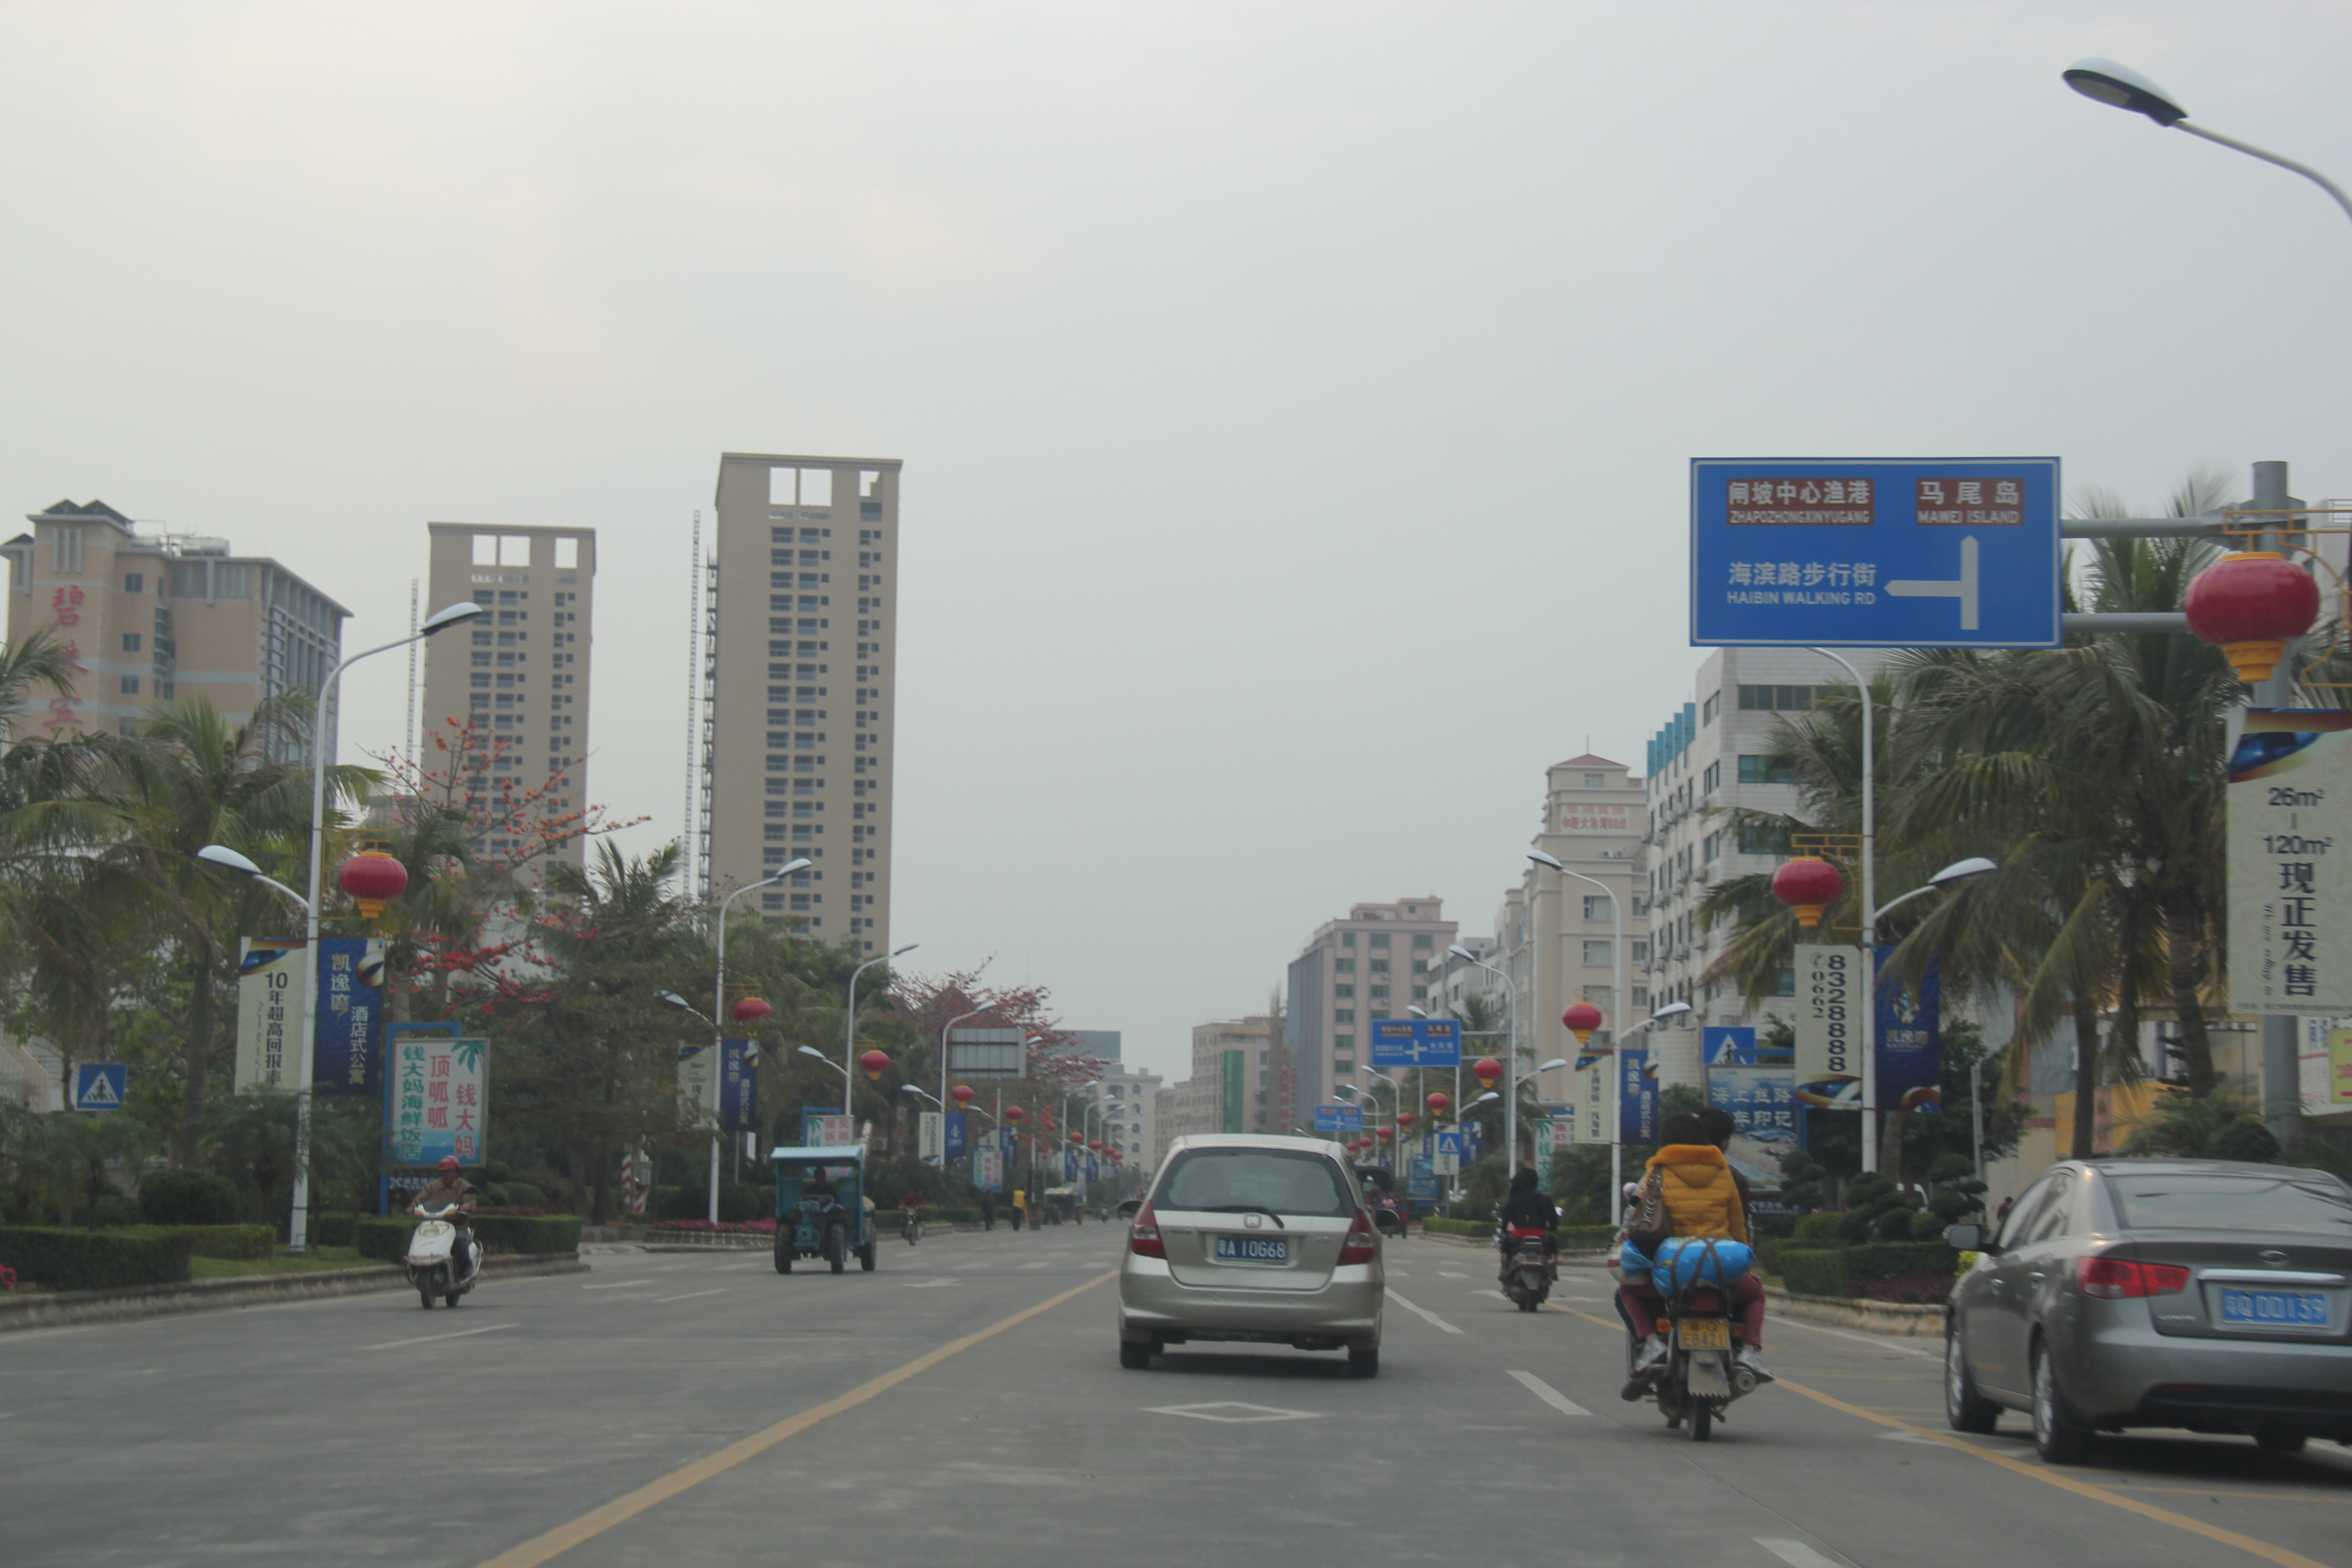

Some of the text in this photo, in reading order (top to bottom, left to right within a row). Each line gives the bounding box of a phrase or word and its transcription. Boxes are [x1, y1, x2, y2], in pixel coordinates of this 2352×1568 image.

[1728, 480, 1870, 505] 闸坡中心渔港
[1919, 480, 2019, 505] 马尾岛
[1917, 510, 2019, 523] MAWEI ISLAND
[1727, 591, 1876, 604] HAIBIN WALKING RD
[1728, 562, 1876, 587] 海滨路步行街
[2278, 862, 2318, 996] 现正发售
[330, 953, 352, 1023] 凯逸湾
[1828, 955, 1846, 1072] 8328888
[348, 1006, 369, 1084] 酒店式公寓
[400, 1046, 425, 1160] 钱大妈海鲜饭店
[427, 1055, 451, 1129] 顶呱呱
[454, 1083, 476, 1159] 钱大妈
[1731, 1110, 1793, 1127] 年印记
[1242, 1240, 1286, 1258] 10668
